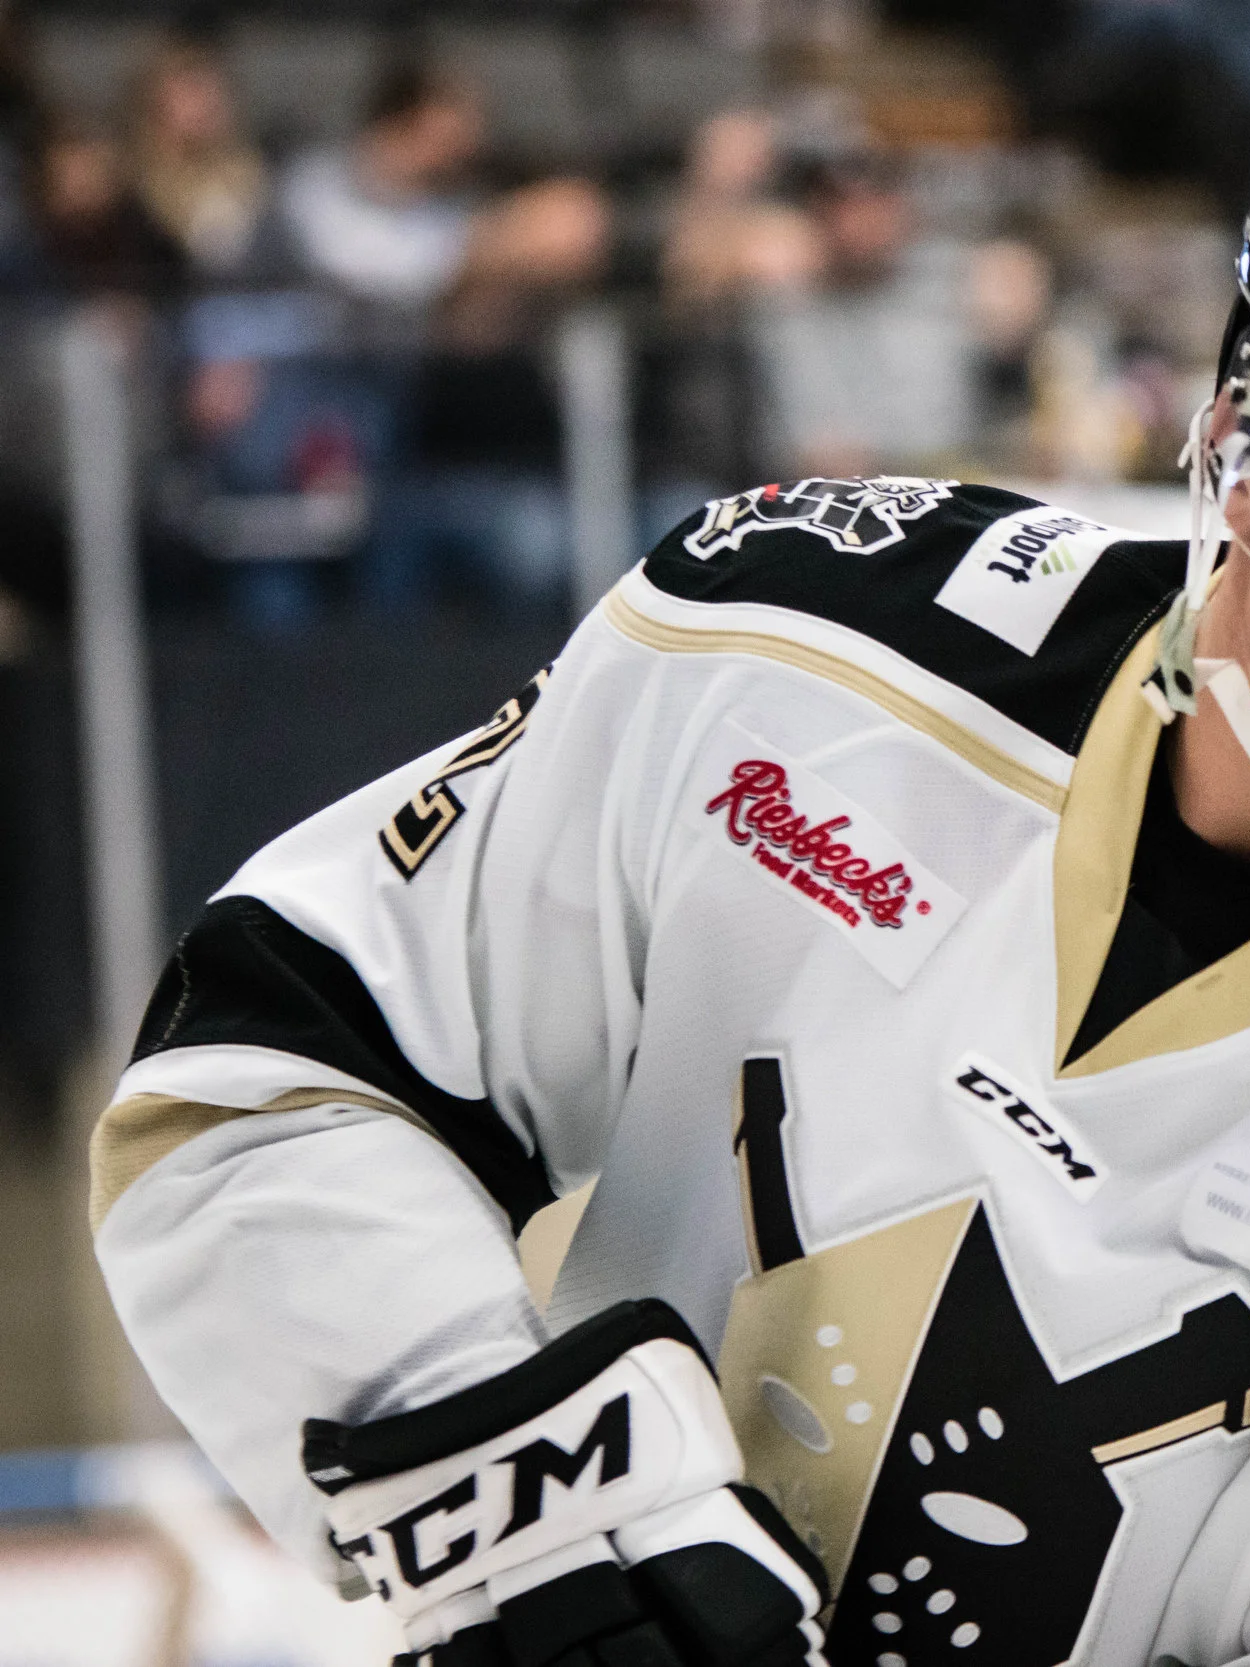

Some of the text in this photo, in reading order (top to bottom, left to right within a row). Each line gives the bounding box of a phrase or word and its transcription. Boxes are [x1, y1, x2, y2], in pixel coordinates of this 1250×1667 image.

[987, 517, 1108, 583] fport
[705, 760, 912, 928] Riesbeck's
[955, 1064, 1098, 1182] CCM
